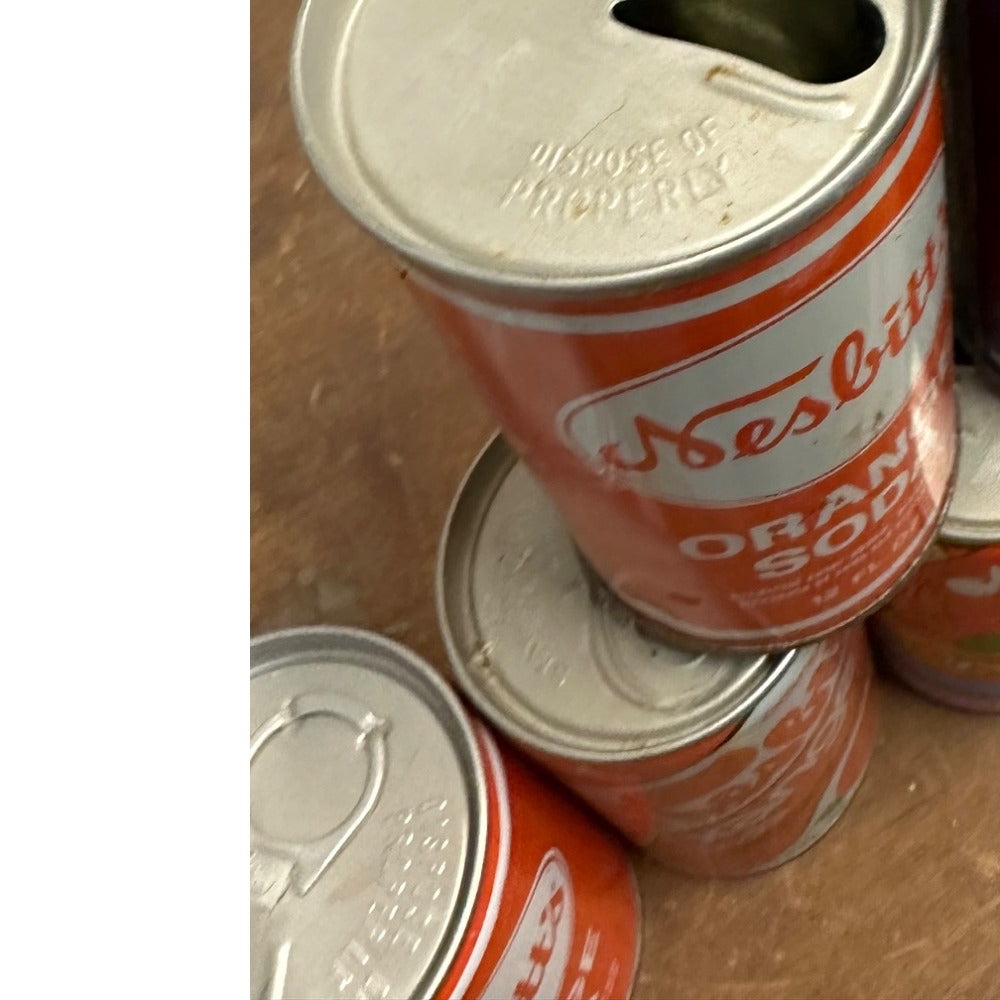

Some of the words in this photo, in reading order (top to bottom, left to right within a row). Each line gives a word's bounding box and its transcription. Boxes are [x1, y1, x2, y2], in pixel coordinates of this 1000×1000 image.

[530, 138, 673, 180] DISPOSE
[680, 116, 718, 157] OF
[500, 150, 730, 222] PROPERLY
